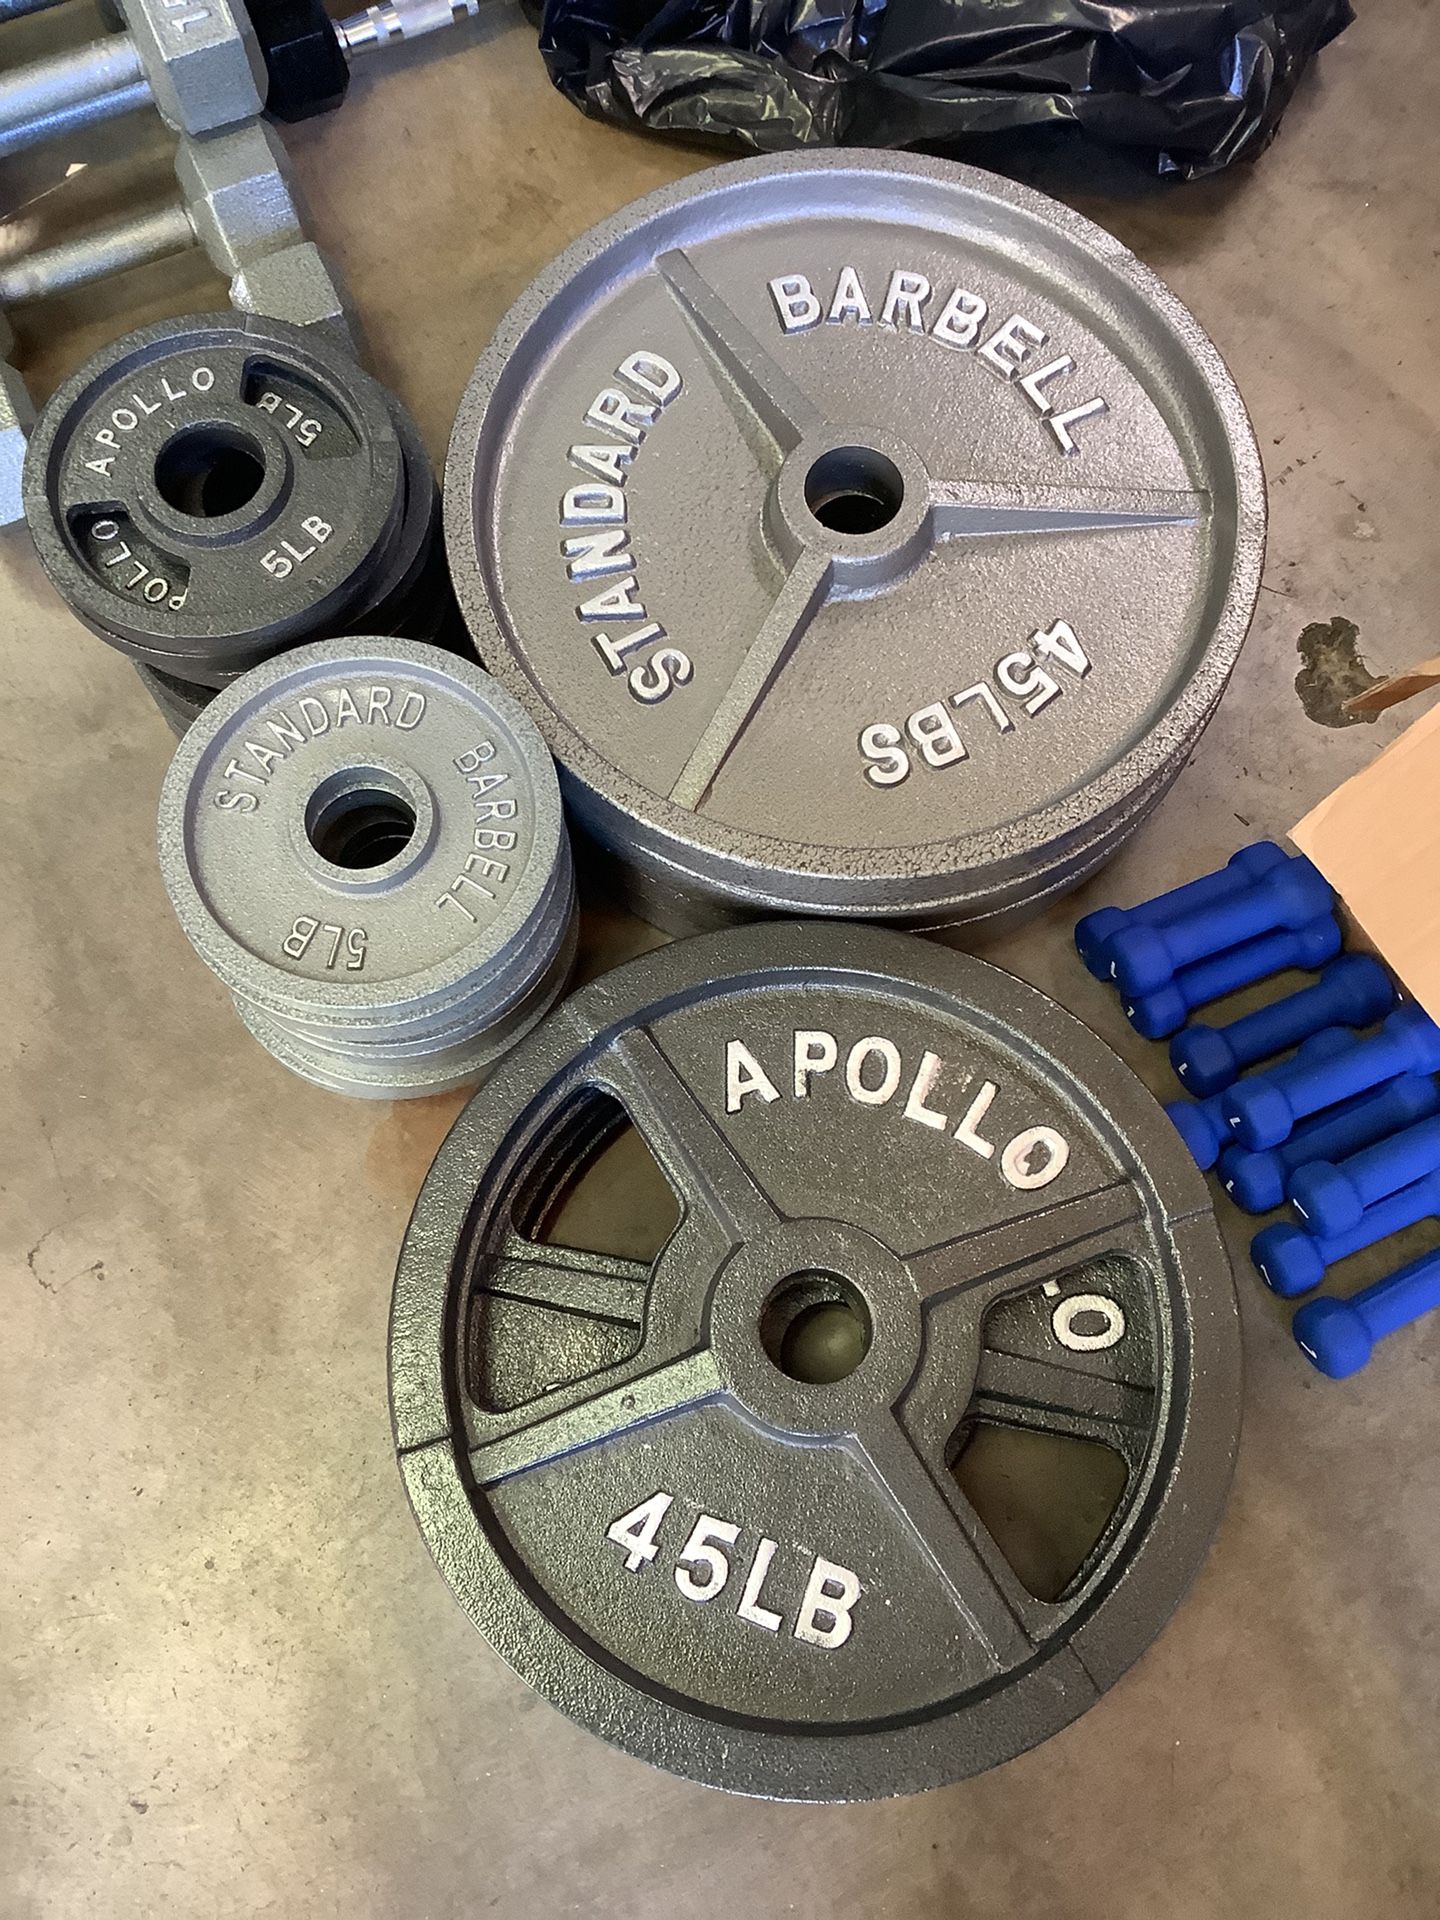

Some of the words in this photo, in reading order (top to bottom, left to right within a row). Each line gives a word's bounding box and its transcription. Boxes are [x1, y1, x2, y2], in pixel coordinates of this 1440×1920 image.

[162, 0, 212, 34] 1
[85, 366, 216, 478] APOLLO
[767, 266, 1110, 456] BARBELL
[259, 515, 334, 580] 5LB
[560, 350, 695, 705] STANDARD
[213, 685, 428, 815] STANDARD
[435, 739, 519, 924] BARBELL
[281, 914, 369, 971] 5LB
[725, 1030, 1070, 1191] APOLLO
[604, 1491, 863, 1650] 45LB
